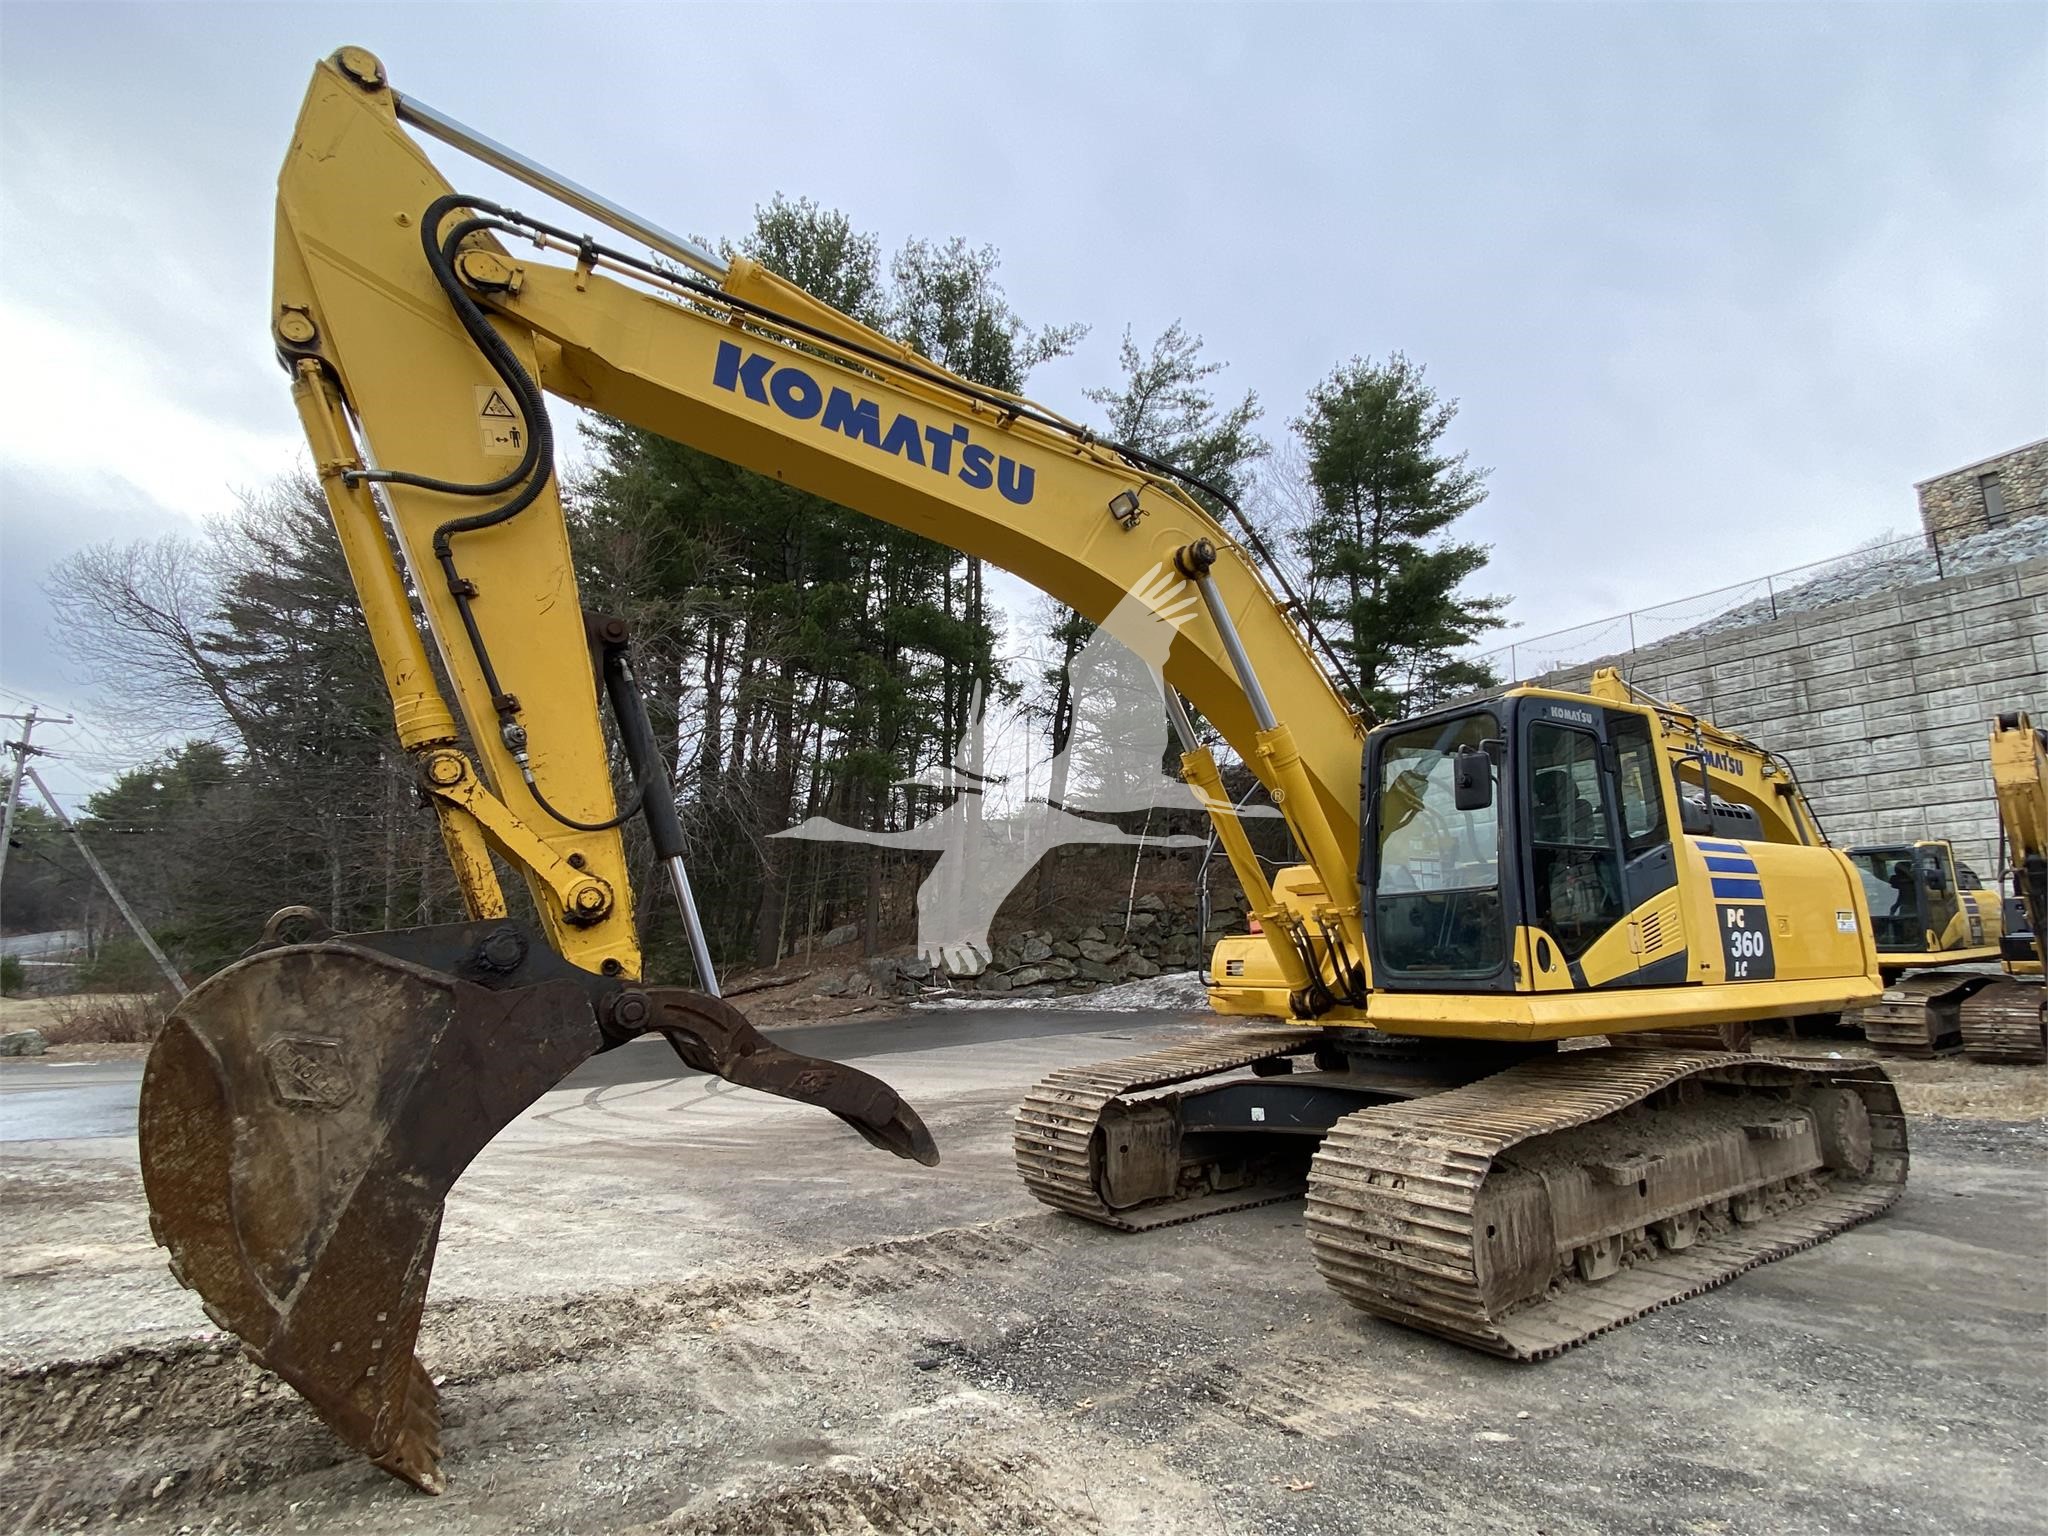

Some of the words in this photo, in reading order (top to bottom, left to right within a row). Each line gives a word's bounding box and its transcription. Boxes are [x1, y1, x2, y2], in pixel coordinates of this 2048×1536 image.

[713, 340, 1036, 505] KOMATSU
[1551, 706, 1593, 724] KOMATSU
[1685, 742, 1744, 777] MATSU
[1726, 908, 1745, 928] PC
[1731, 931, 1764, 957] 360
[1734, 960, 1748, 977] LC
